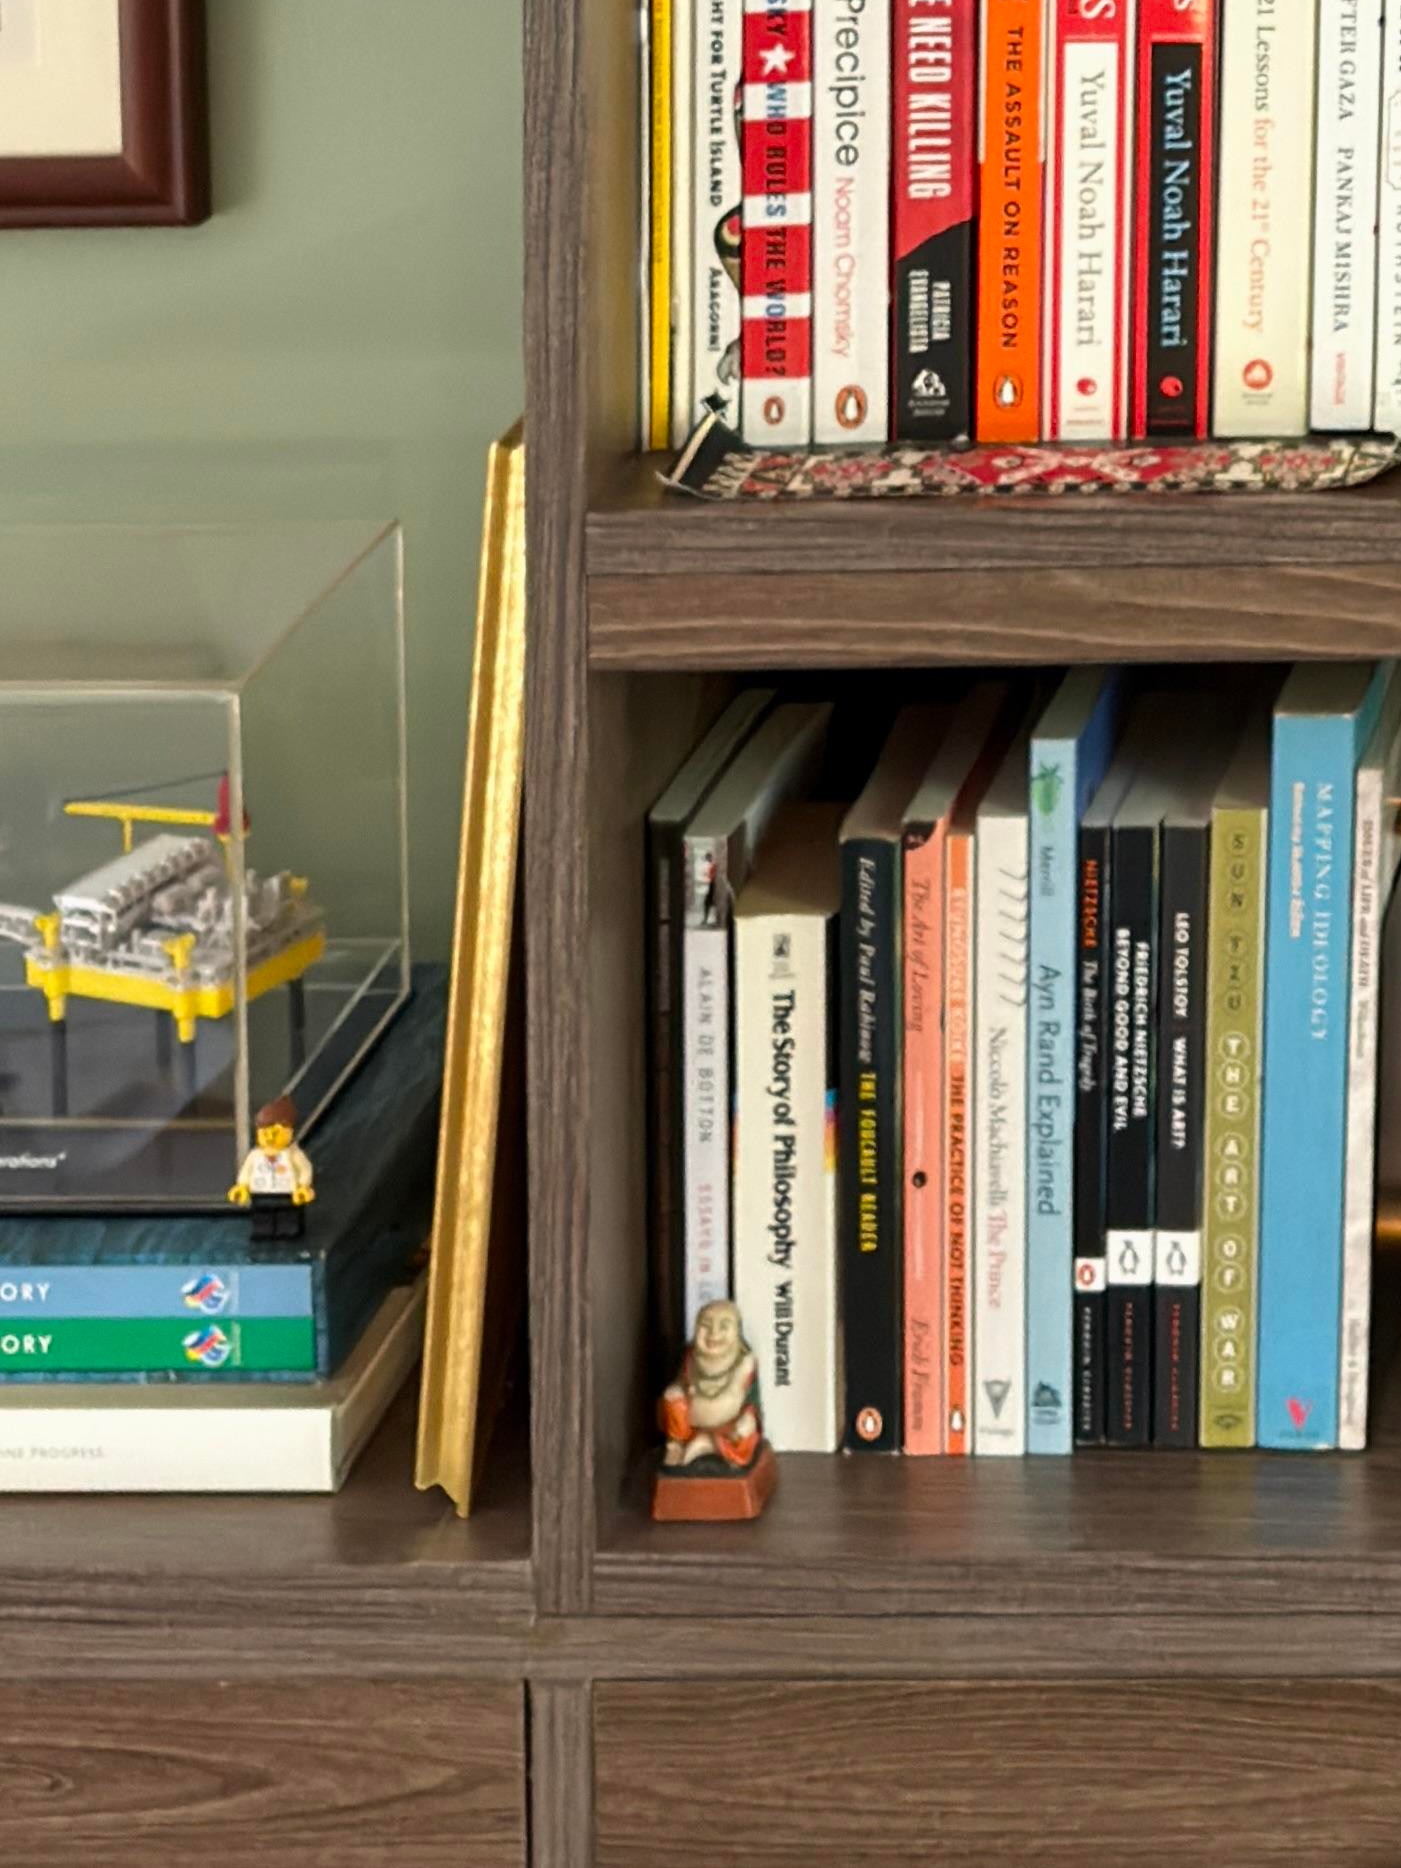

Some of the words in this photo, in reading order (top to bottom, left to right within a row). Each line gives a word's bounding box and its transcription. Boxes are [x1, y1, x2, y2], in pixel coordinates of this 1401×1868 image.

[908, 20, 952, 90] NEED
[907, 98, 952, 200] KILLING
[770, 990, 797, 1034] The
[765, 1037, 796, 1097] Story
[772, 1102, 796, 1128] of
[767, 1135, 797, 1269] Philosophy
